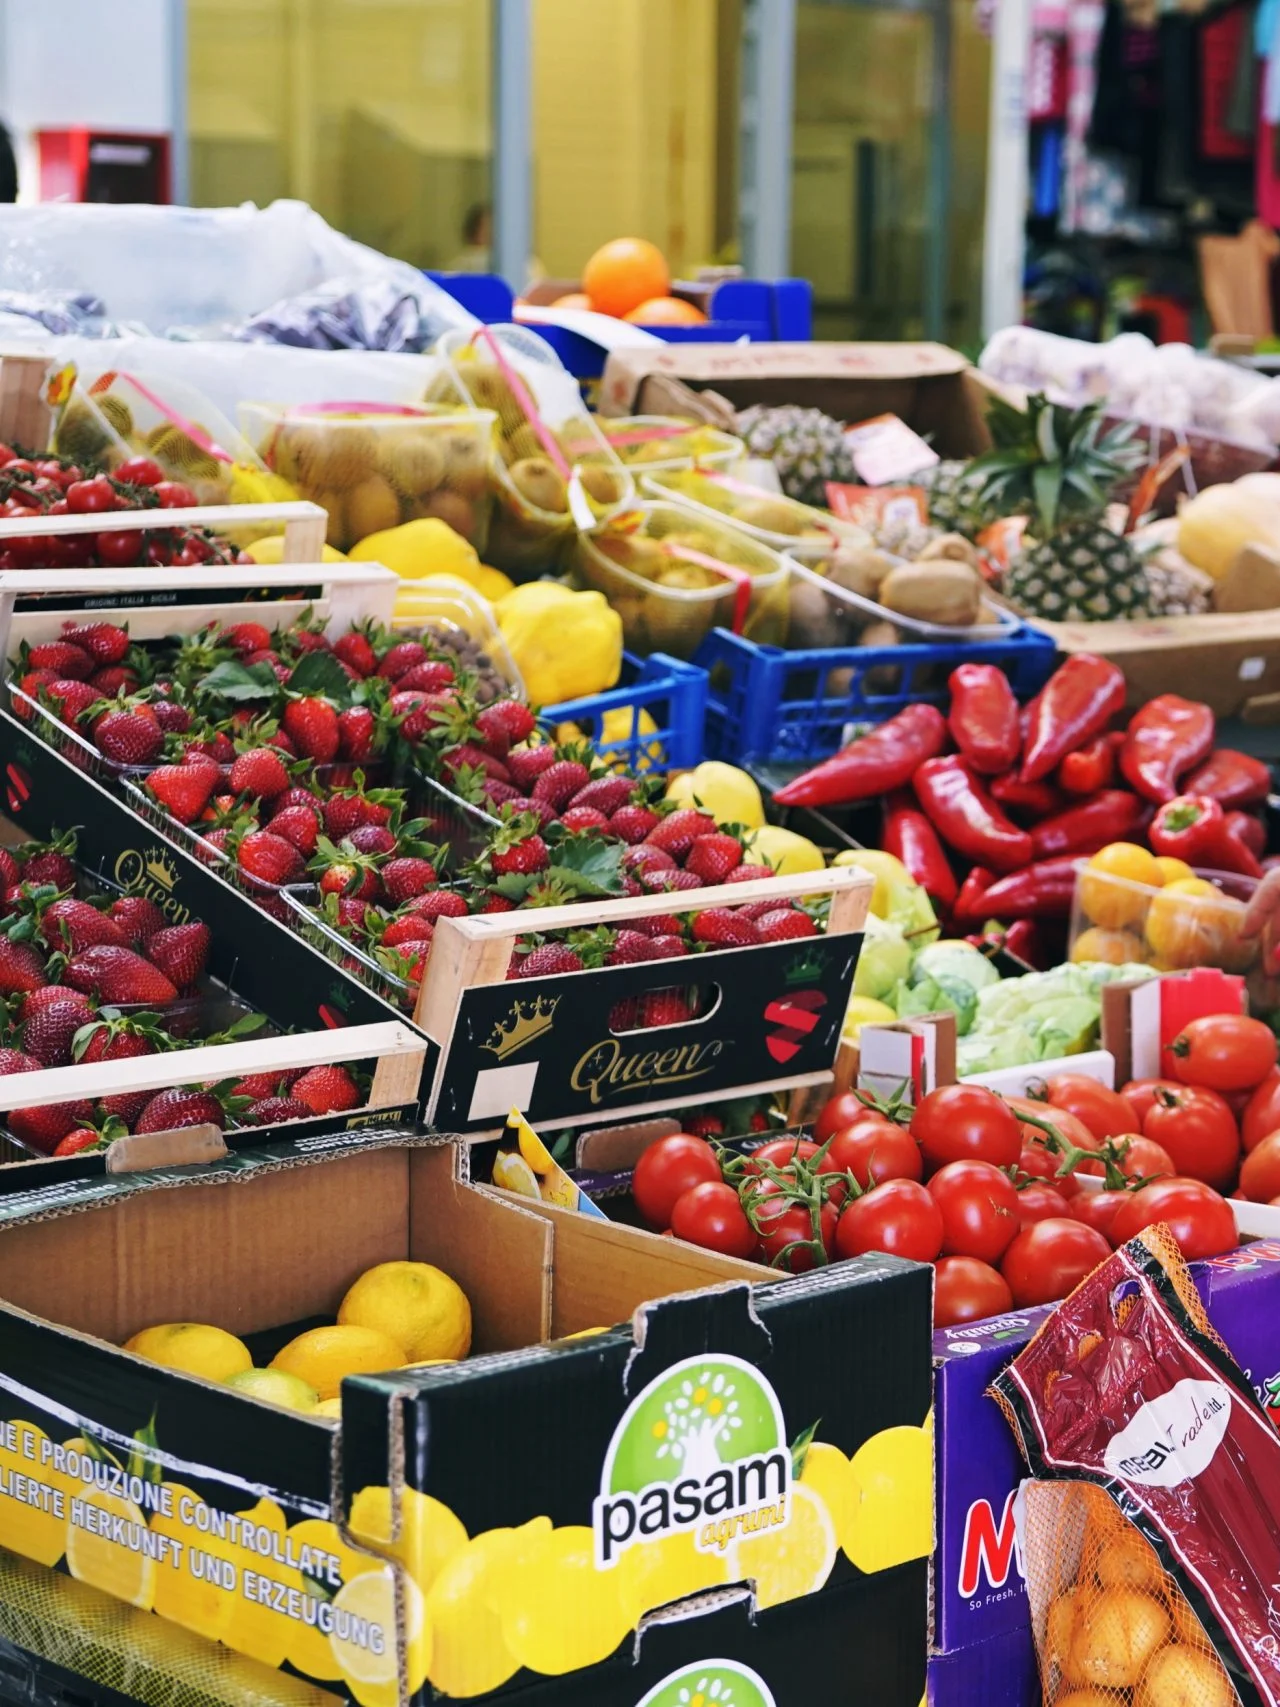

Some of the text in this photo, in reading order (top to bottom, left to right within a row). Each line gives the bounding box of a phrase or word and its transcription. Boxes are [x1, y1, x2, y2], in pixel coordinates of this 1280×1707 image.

[570, 1039, 730, 1104] Queen
[23, 1429, 35, 1460] E
[41, 1436, 174, 1517] PRODUZIONE
[179, 1495, 342, 1587] CONTROLLATE
[603, 1454, 787, 1561] pasam
[701, 1494, 786, 1550] agrumi
[71, 1496, 183, 1569] HERKUNFT
[189, 1546, 237, 1591] UND
[243, 1568, 386, 1655] ERZEUGUNG
[969, 1600, 982, 1611] So
